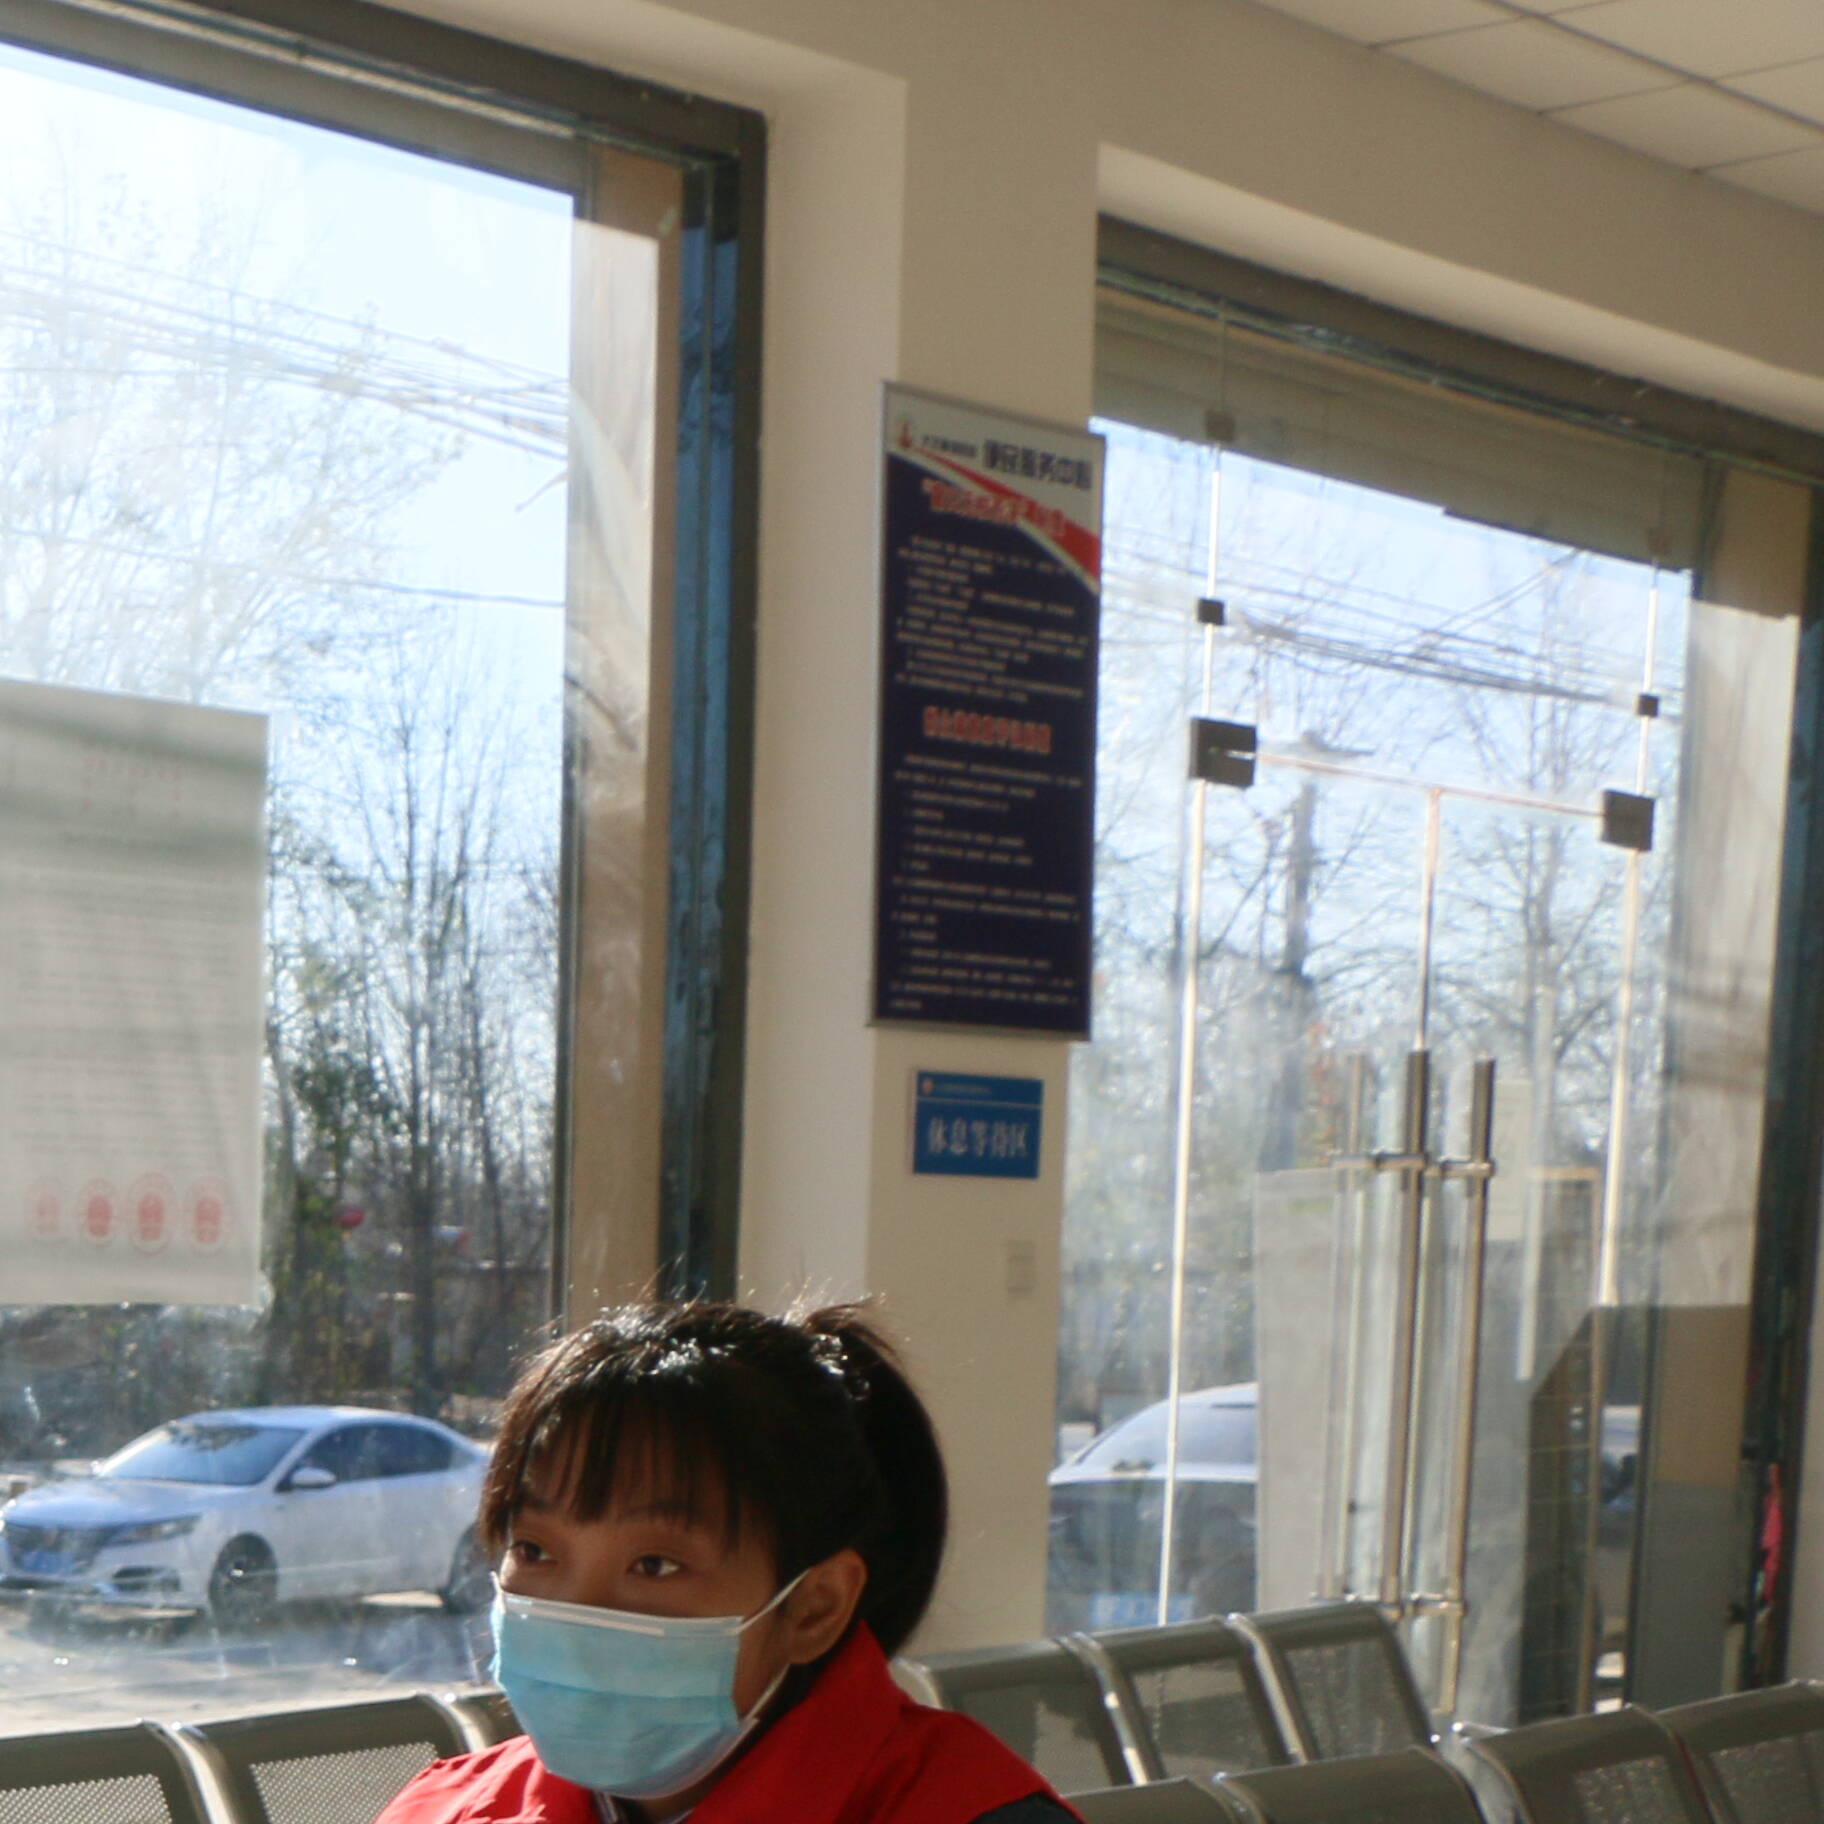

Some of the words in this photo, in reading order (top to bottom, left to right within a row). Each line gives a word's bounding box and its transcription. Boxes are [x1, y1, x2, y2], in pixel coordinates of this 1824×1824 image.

[927, 1117, 1030, 1158] 休息等待区
